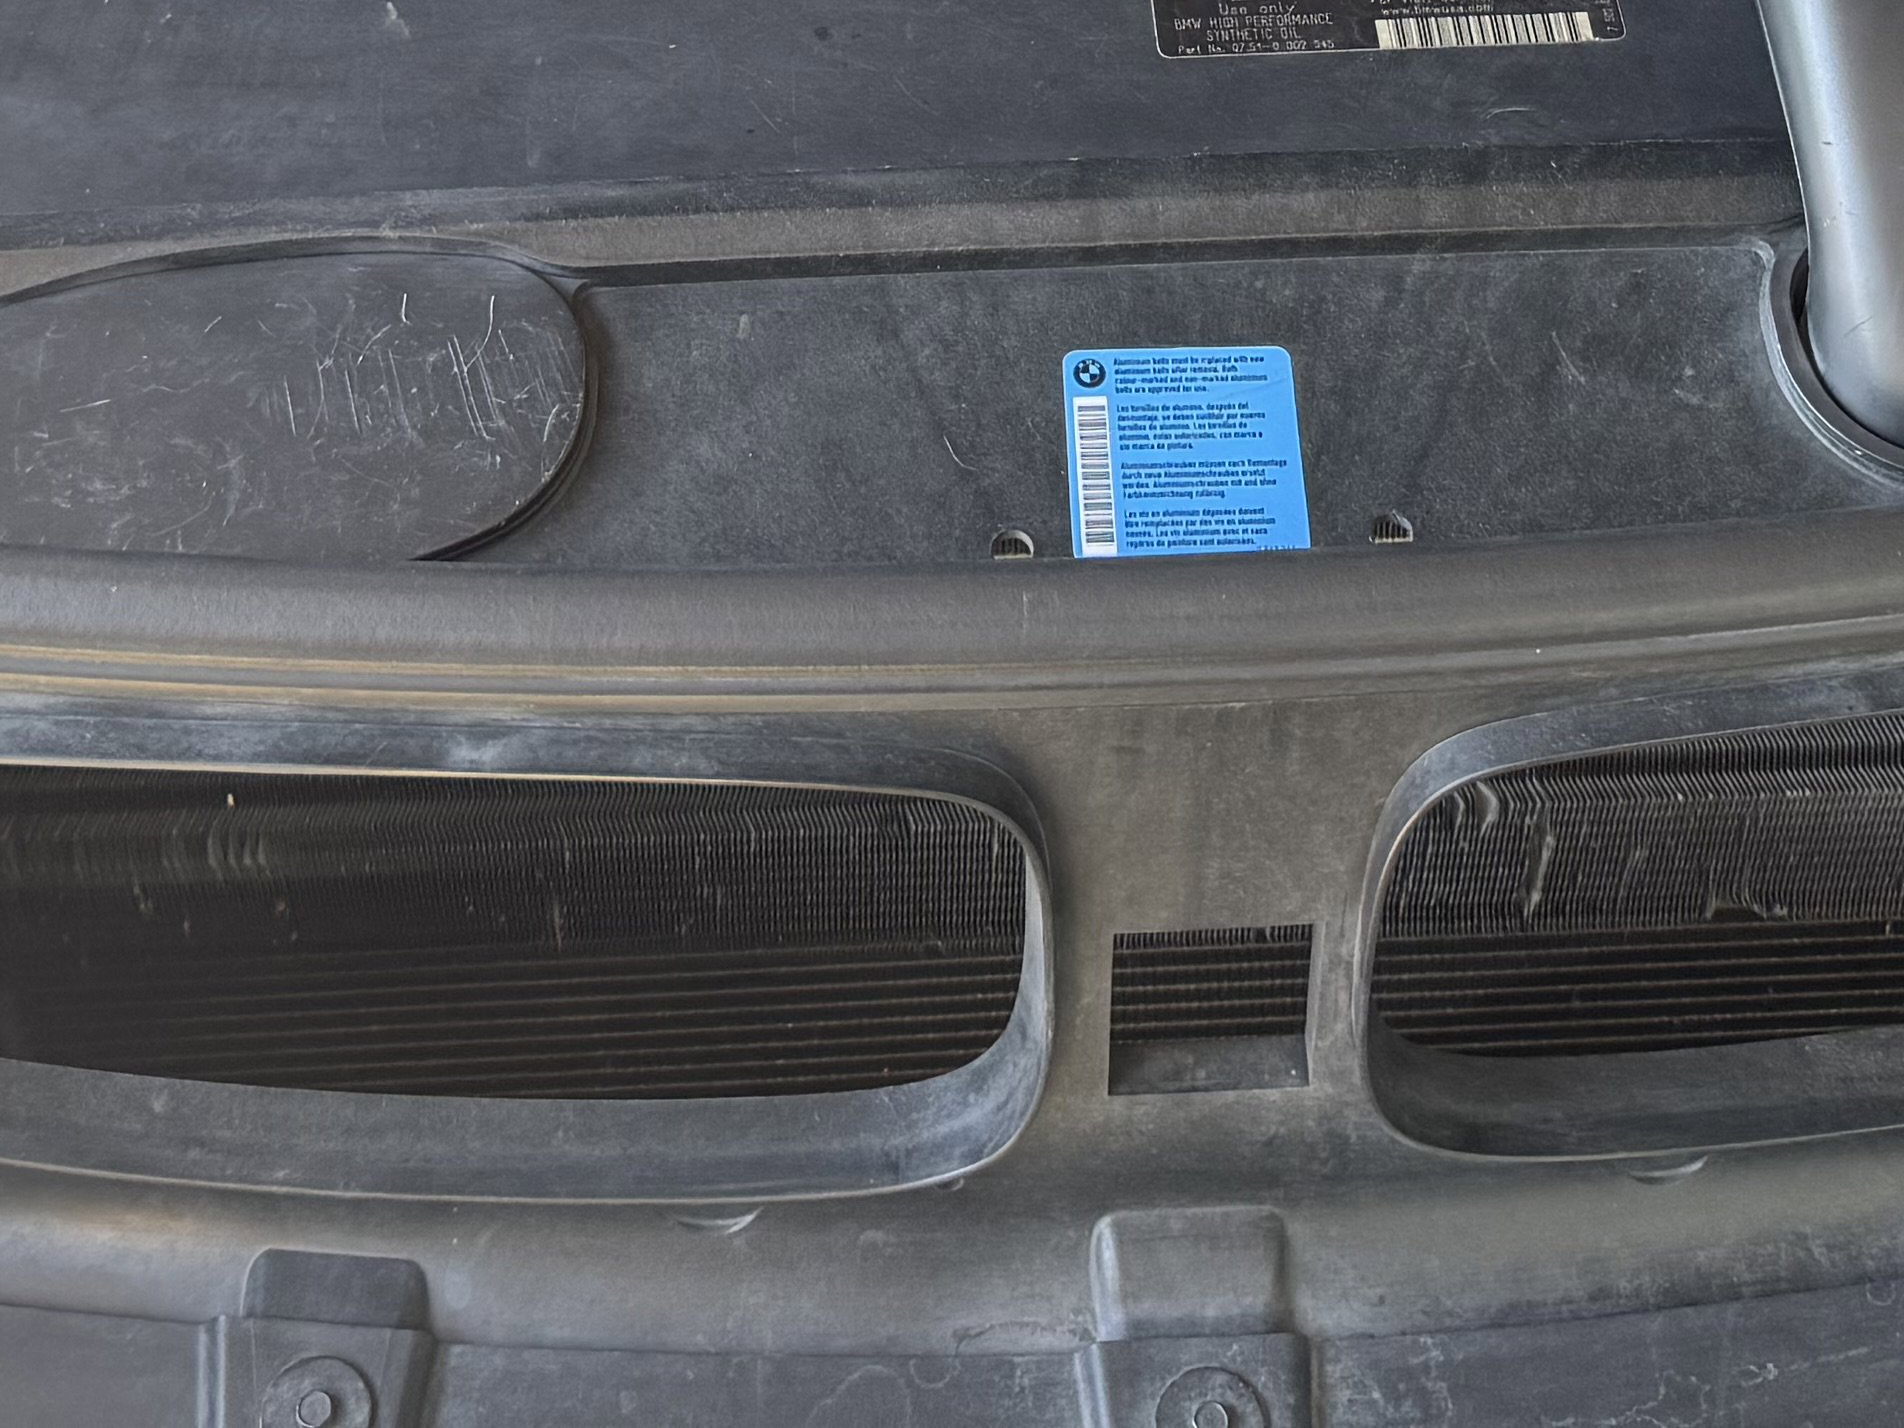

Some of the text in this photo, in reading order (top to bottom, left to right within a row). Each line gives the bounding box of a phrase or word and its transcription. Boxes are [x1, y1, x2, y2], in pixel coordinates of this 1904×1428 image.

[1219, 1, 1295, 17] Use only
[1174, 17, 1201, 30] BMW
[1246, 12, 1333, 28] PERFORMANCE
[1206, 27, 1301, 42] SYNTHETIC OIL
